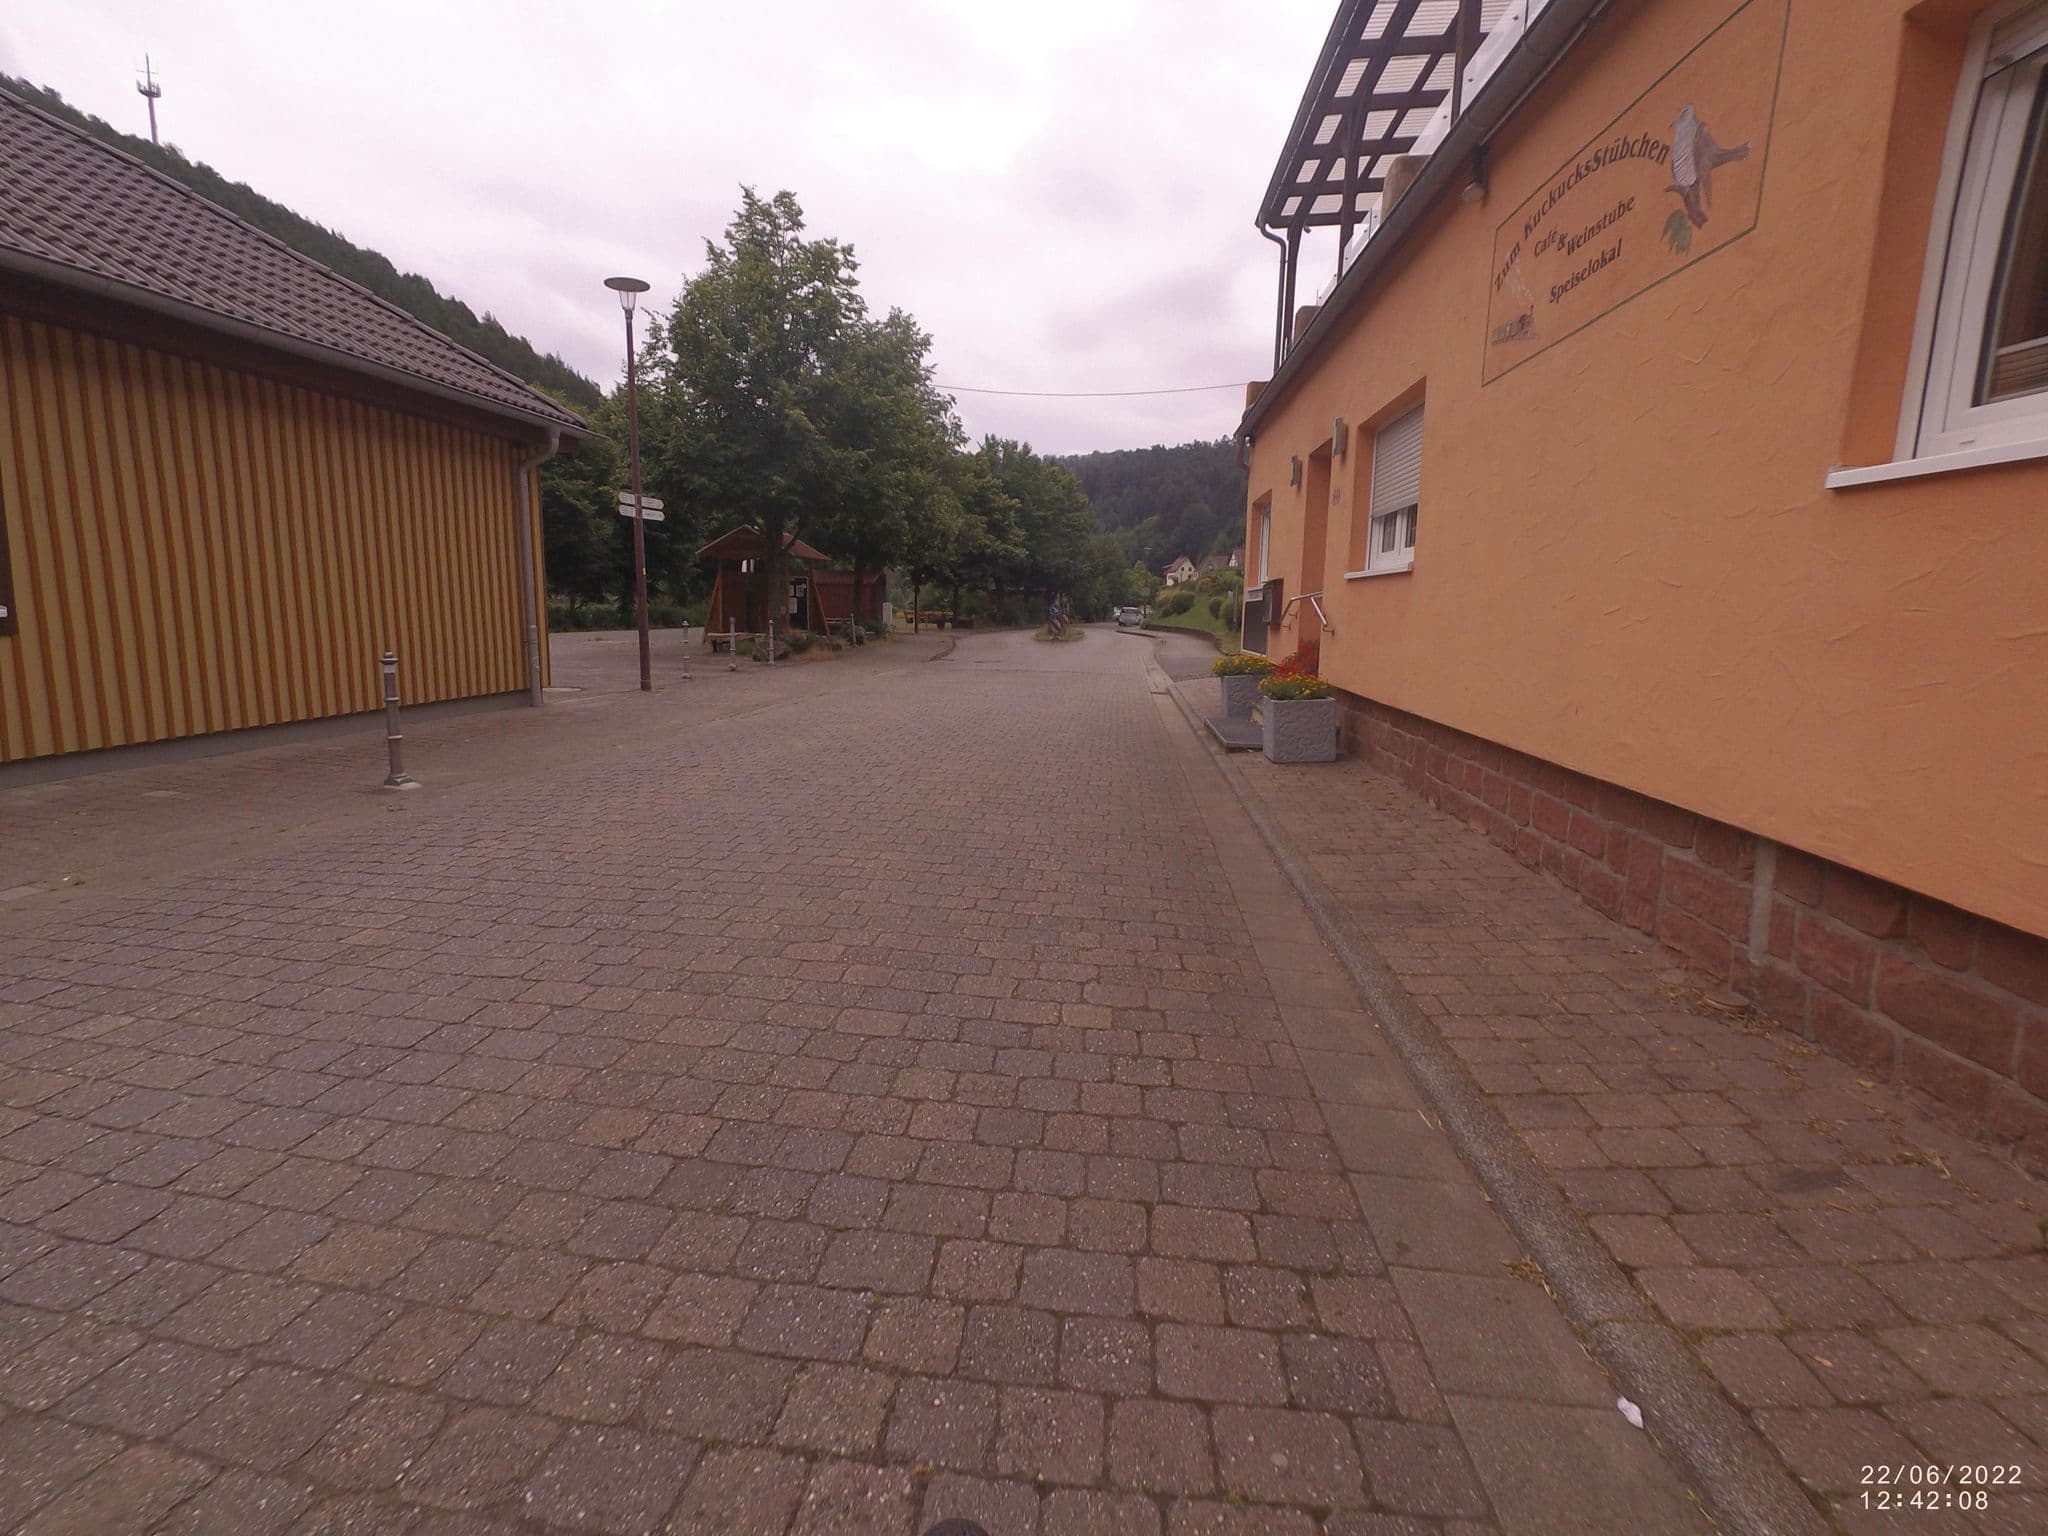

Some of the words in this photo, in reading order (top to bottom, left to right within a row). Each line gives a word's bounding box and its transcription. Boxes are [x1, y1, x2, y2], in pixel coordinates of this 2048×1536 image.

[1523, 131, 1670, 241] KuckucksStübchen
[1557, 232, 1568, 252] &
[1567, 196, 1635, 256] Weinstube
[1549, 237, 1622, 304] Speiselokal
